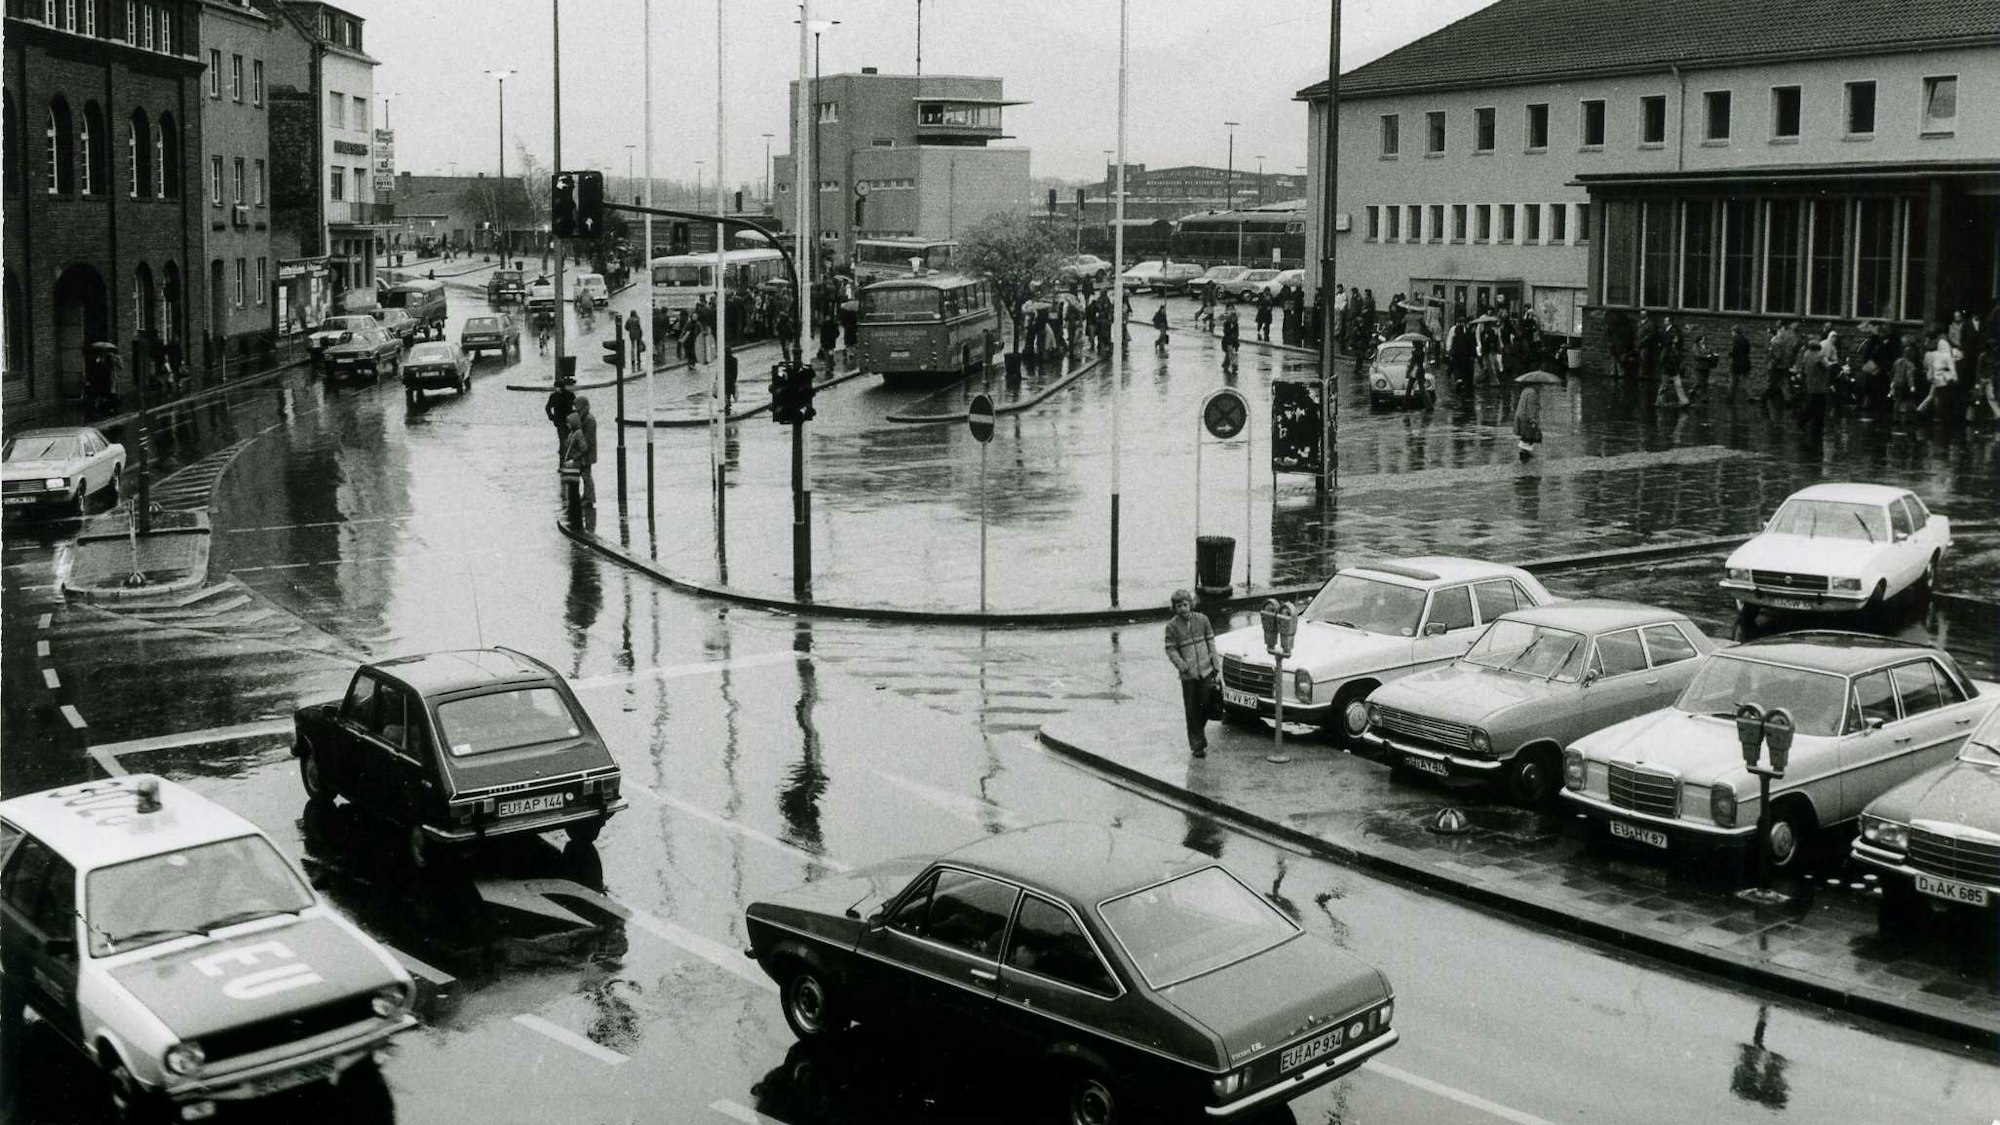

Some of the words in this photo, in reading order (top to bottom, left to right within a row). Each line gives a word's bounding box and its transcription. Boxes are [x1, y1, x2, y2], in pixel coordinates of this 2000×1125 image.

[544, 795, 562, 808] 144
[1651, 832, 1665, 846] 87
[1959, 887, 1984, 902] 685
[191, 941, 325, 1000] EU
[1322, 1031, 1342, 1052] 934
